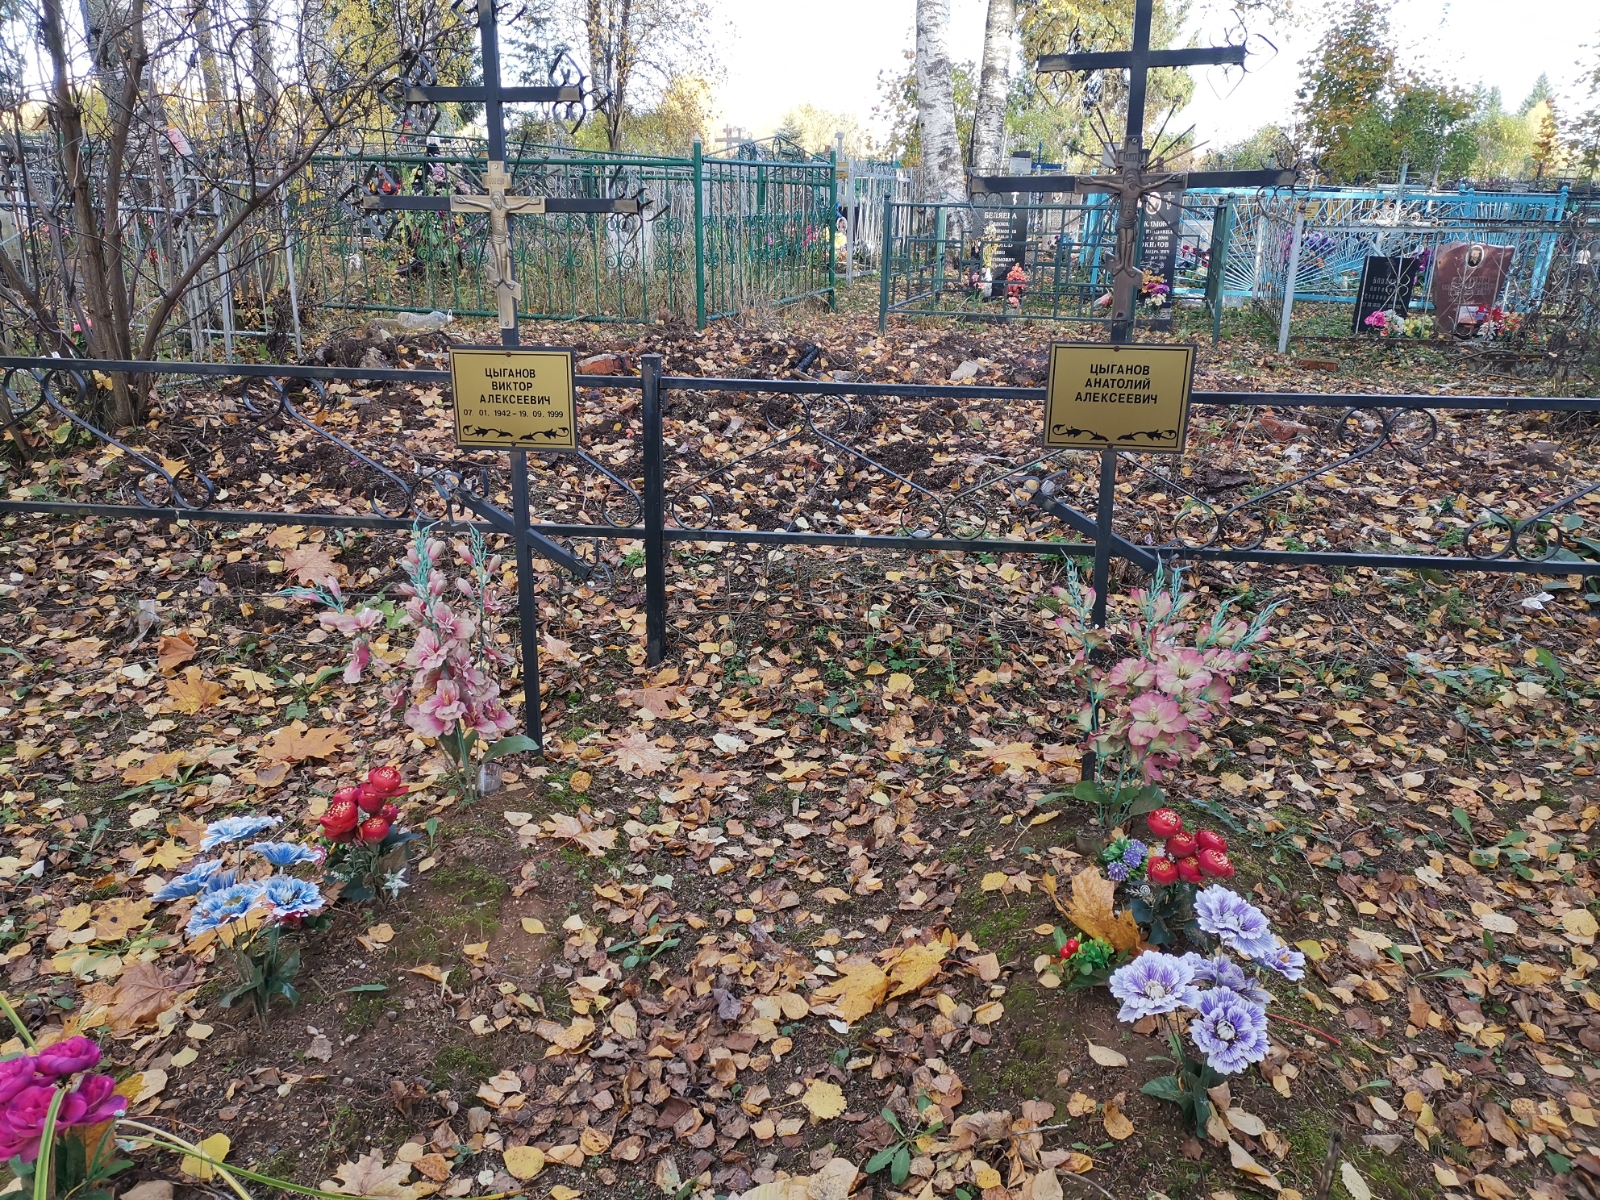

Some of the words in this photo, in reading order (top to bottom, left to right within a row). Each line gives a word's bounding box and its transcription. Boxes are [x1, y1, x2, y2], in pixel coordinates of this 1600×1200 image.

[484, 367, 536, 379] ЦЫГАНОВ
[1090, 363, 1150, 376] ЦЫГАНОВ
[491, 381, 533, 391] ВИКТОР
[1085, 377, 1151, 390] АНАТОЛИЙ
[479, 394, 551, 405] АЛЕКСЕЕВИЧ
[1075, 391, 1158, 404] АЛЕКСЕЕВИЧ
[494, 409, 511, 417] 1942
[532, 410, 545, 418] 09.
[547, 410, 564, 418] 1999
